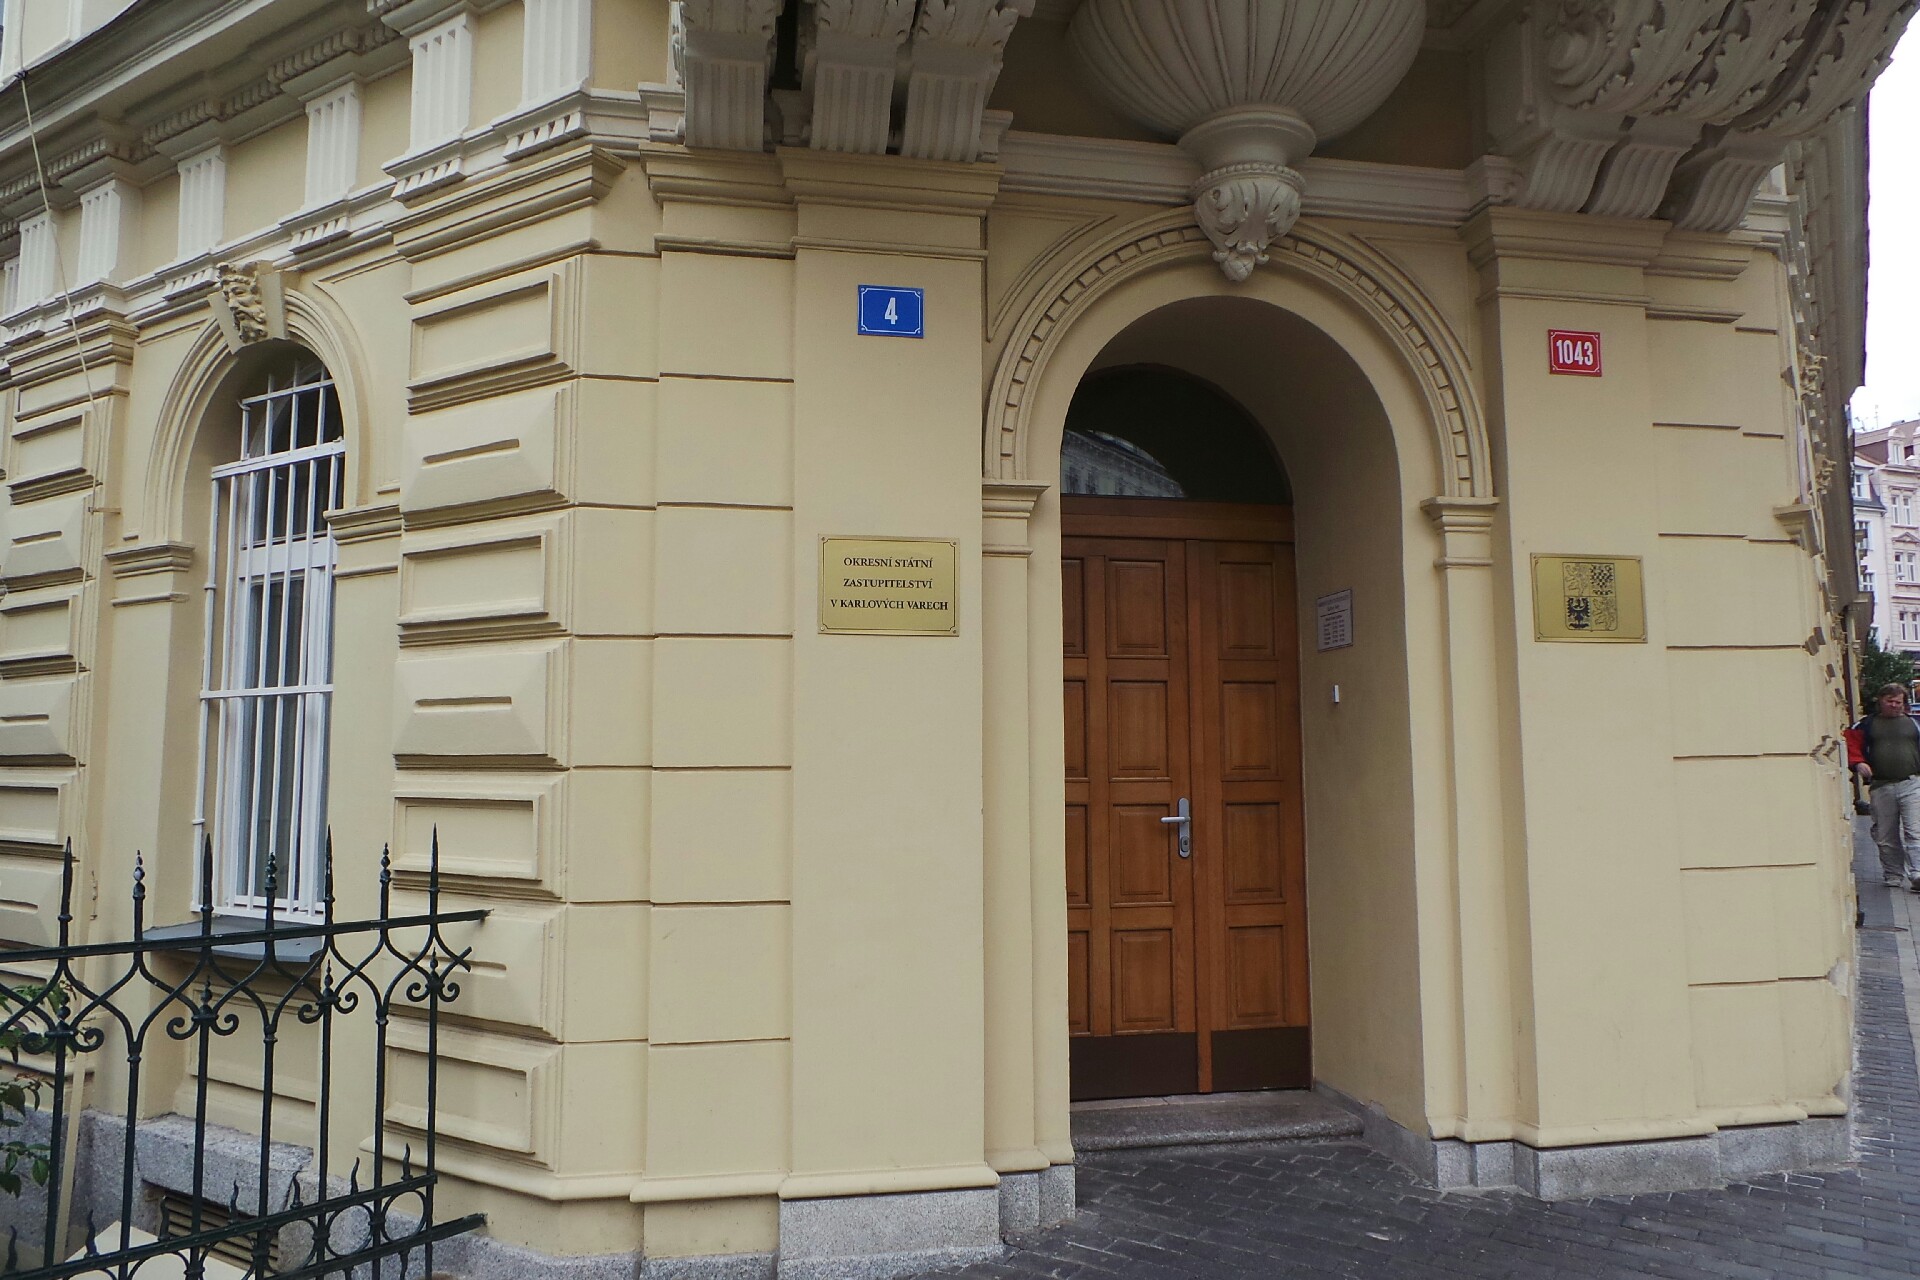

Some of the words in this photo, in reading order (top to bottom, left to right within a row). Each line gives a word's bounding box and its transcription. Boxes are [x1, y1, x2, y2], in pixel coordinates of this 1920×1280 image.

[884, 297, 898, 325] 4
[1556, 339, 1594, 366] 1043
[843, 556, 893, 568] OKRESNÍ
[894, 556, 934, 568] STÁTNÍ
[843, 578, 933, 589] ZASTUPITELSTVÍ
[830, 599, 838, 608] V
[840, 598, 904, 610] KARLOVÝCH
[906, 601, 949, 611] VARECH
